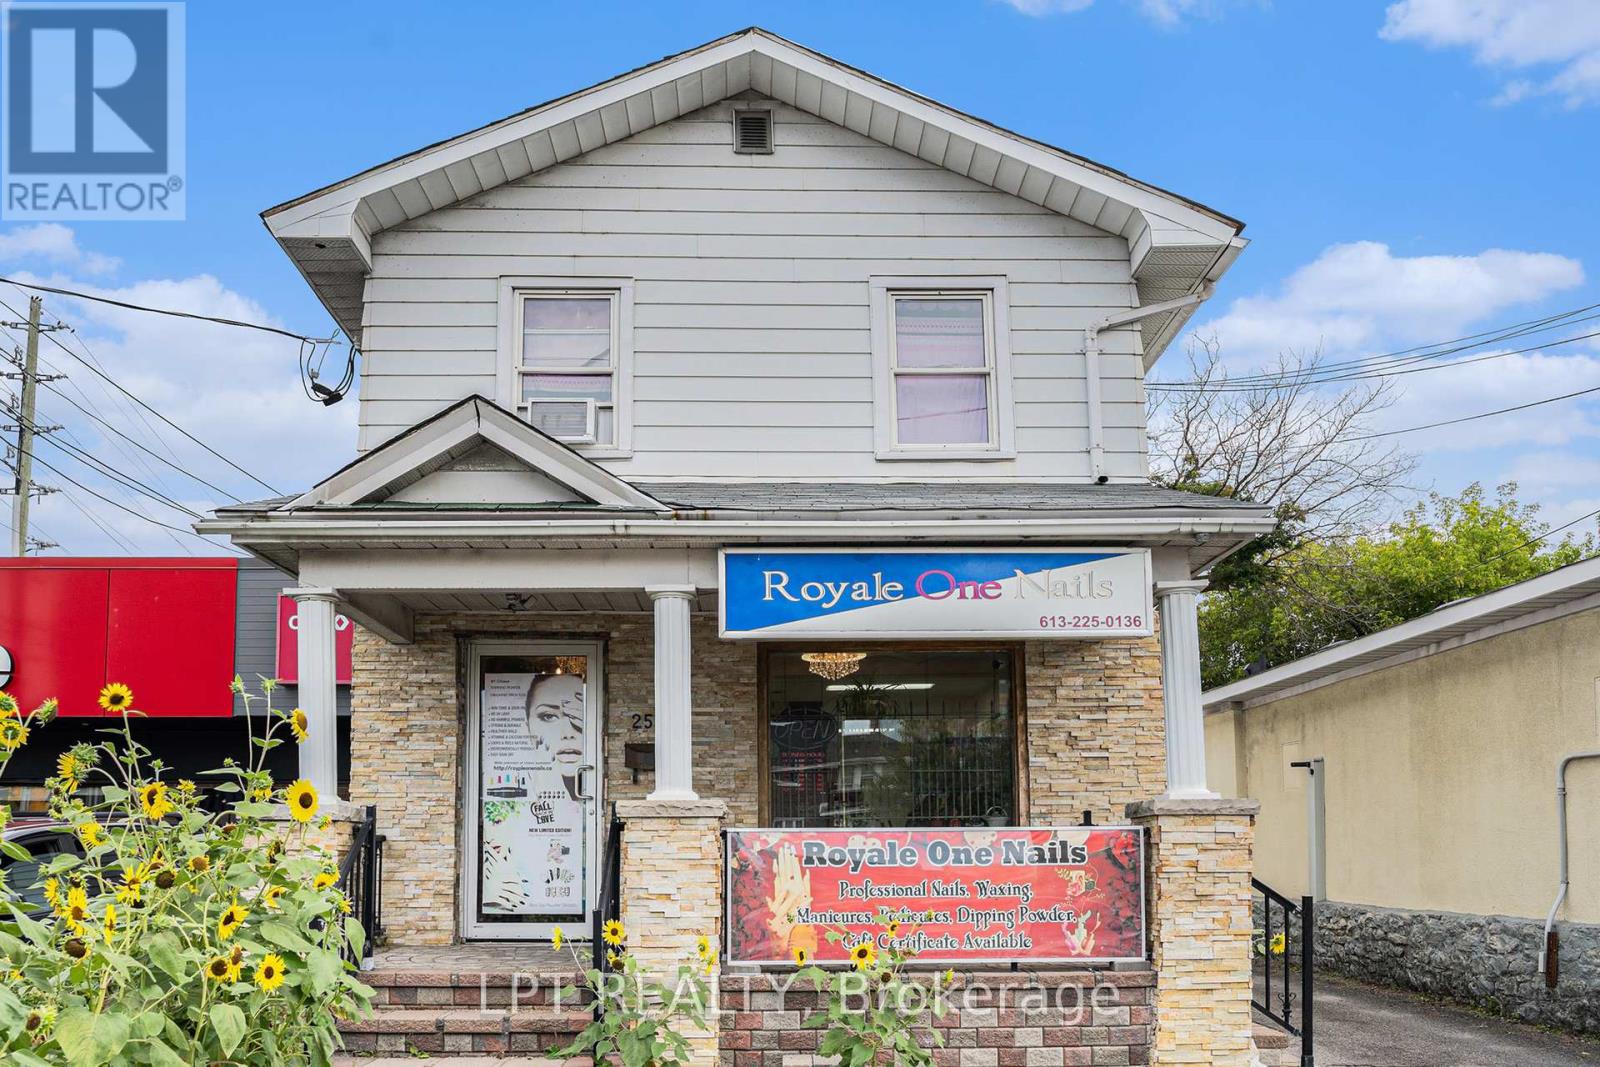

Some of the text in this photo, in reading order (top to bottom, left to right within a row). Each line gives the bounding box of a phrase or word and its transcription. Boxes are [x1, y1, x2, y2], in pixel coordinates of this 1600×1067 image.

[762, 568, 1113, 608] Royale One Nails
[1039, 615, 1142, 628] 613-225-0136
[533, 803, 553, 813] FALL
[536, 815, 555, 825] LOVE
[802, 838, 1087, 872] Royale One Nails
[838, 879, 927, 900] Professional
[957, 906, 1015, 930] Dipping
[877, 932, 958, 951] Certificate
[963, 932, 1033, 949] Available
